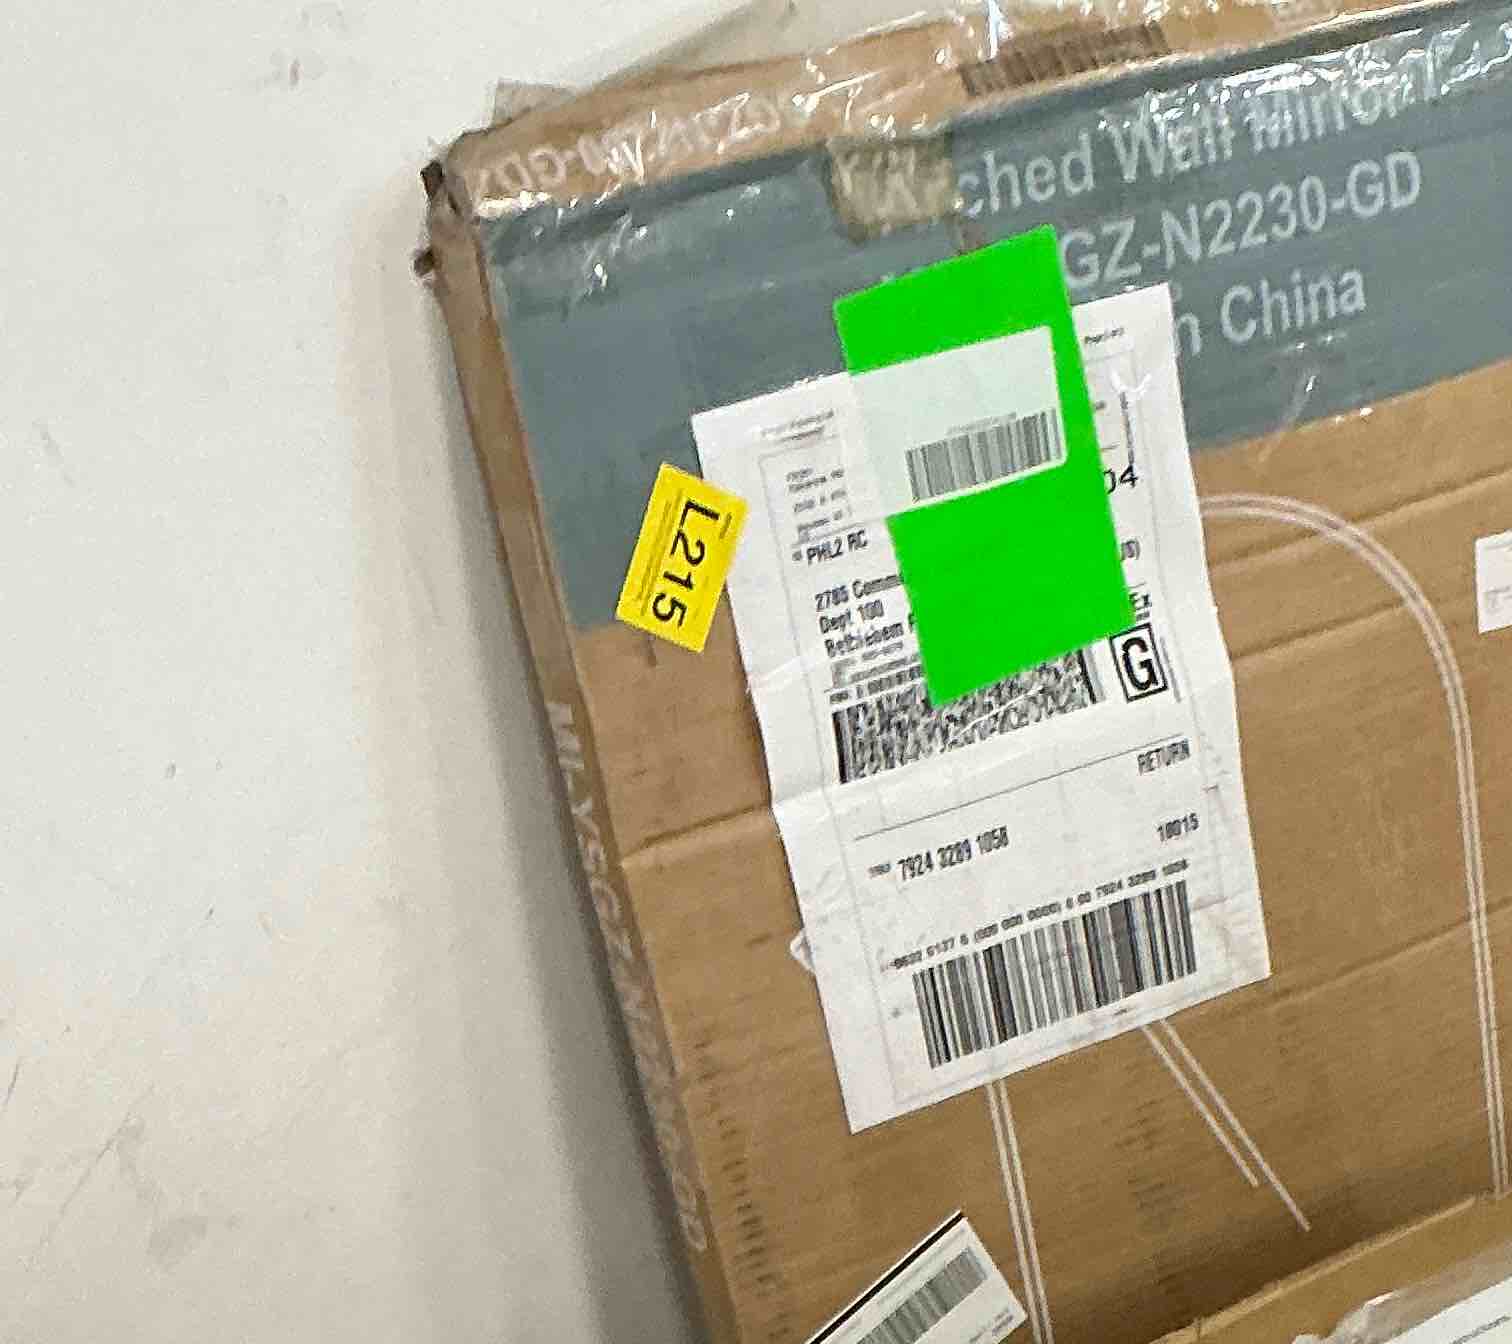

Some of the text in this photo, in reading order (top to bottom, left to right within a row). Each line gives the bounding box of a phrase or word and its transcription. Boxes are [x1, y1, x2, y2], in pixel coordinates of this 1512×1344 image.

[1221, 266, 1366, 345] China
[650, 498, 720, 628] L215
[1121, 635, 1159, 692] G
